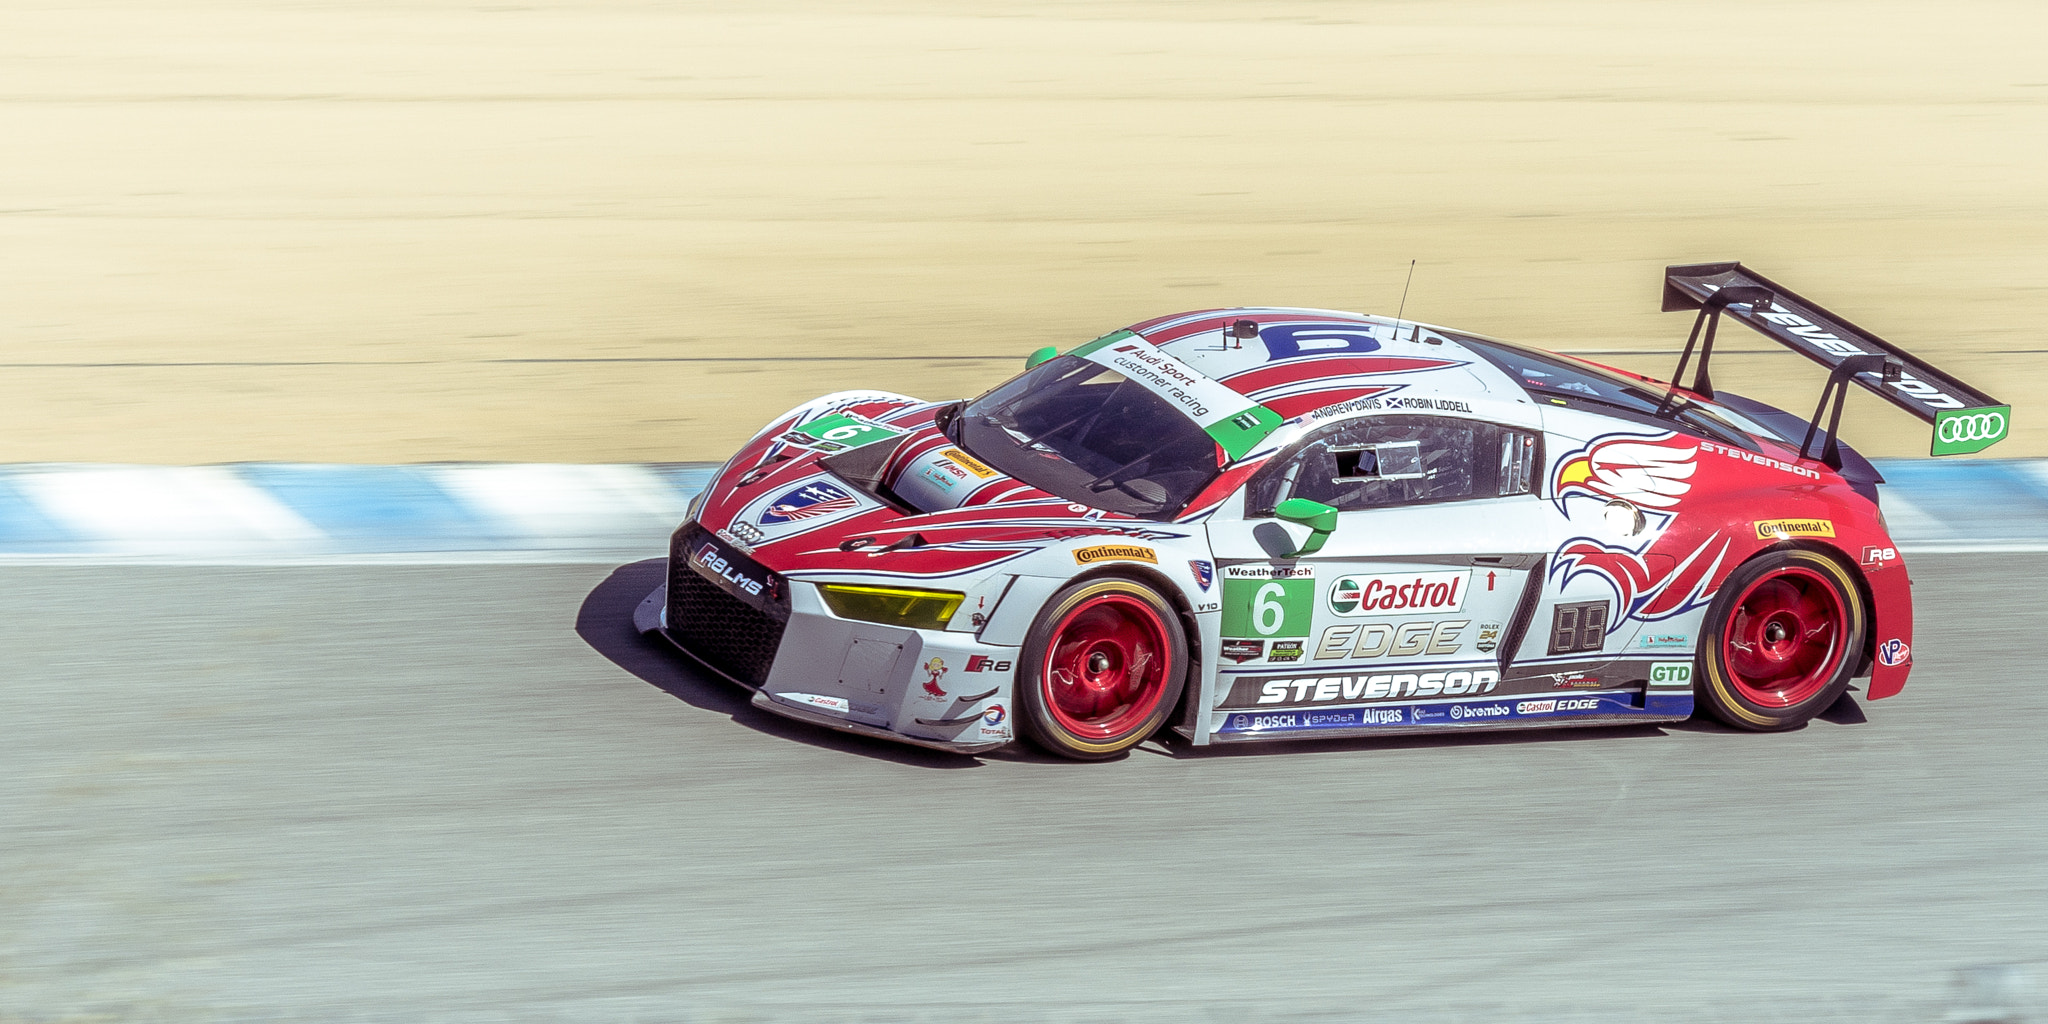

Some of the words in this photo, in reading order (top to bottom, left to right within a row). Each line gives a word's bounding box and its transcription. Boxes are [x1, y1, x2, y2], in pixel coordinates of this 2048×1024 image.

[1257, 324, 1382, 361] 6
[1131, 350, 1163, 369] Audi
[1158, 362, 1196, 387] Sport
[1114, 356, 1171, 389] customer
[1168, 384, 1209, 417] racing
[1314, 402, 1353, 420] ANDREW
[1354, 399, 1382, 411] DAVIS
[1404, 398, 1433, 410] ROBIN
[1436, 400, 1473, 413] LIDDELL
[822, 425, 872, 440] 6
[1700, 441, 1820, 480] STEVENSON
[1758, 521, 1822, 537] Continental
[1077, 546, 1144, 562] Continental
[1869, 548, 1896, 560] R8
[1228, 567, 1313, 577] WeatherTech
[1362, 576, 1460, 611] Castrol
[1253, 582, 1286, 635] 6
[1313, 620, 1471, 660] EDGE
[1479, 630, 1498, 639] 24
[1882, 640, 1900, 664] VP
[976, 660, 1011, 672] R8
[1652, 666, 1690, 681] GTD
[1257, 669, 1499, 704] STEVENSON
[1463, 704, 1510, 718] brembo
[1526, 702, 1553, 712] Castrol
[1556, 699, 1599, 711] EDGE
[1254, 715, 1296, 728] BOSCH
[1363, 708, 1403, 724] Airgas
